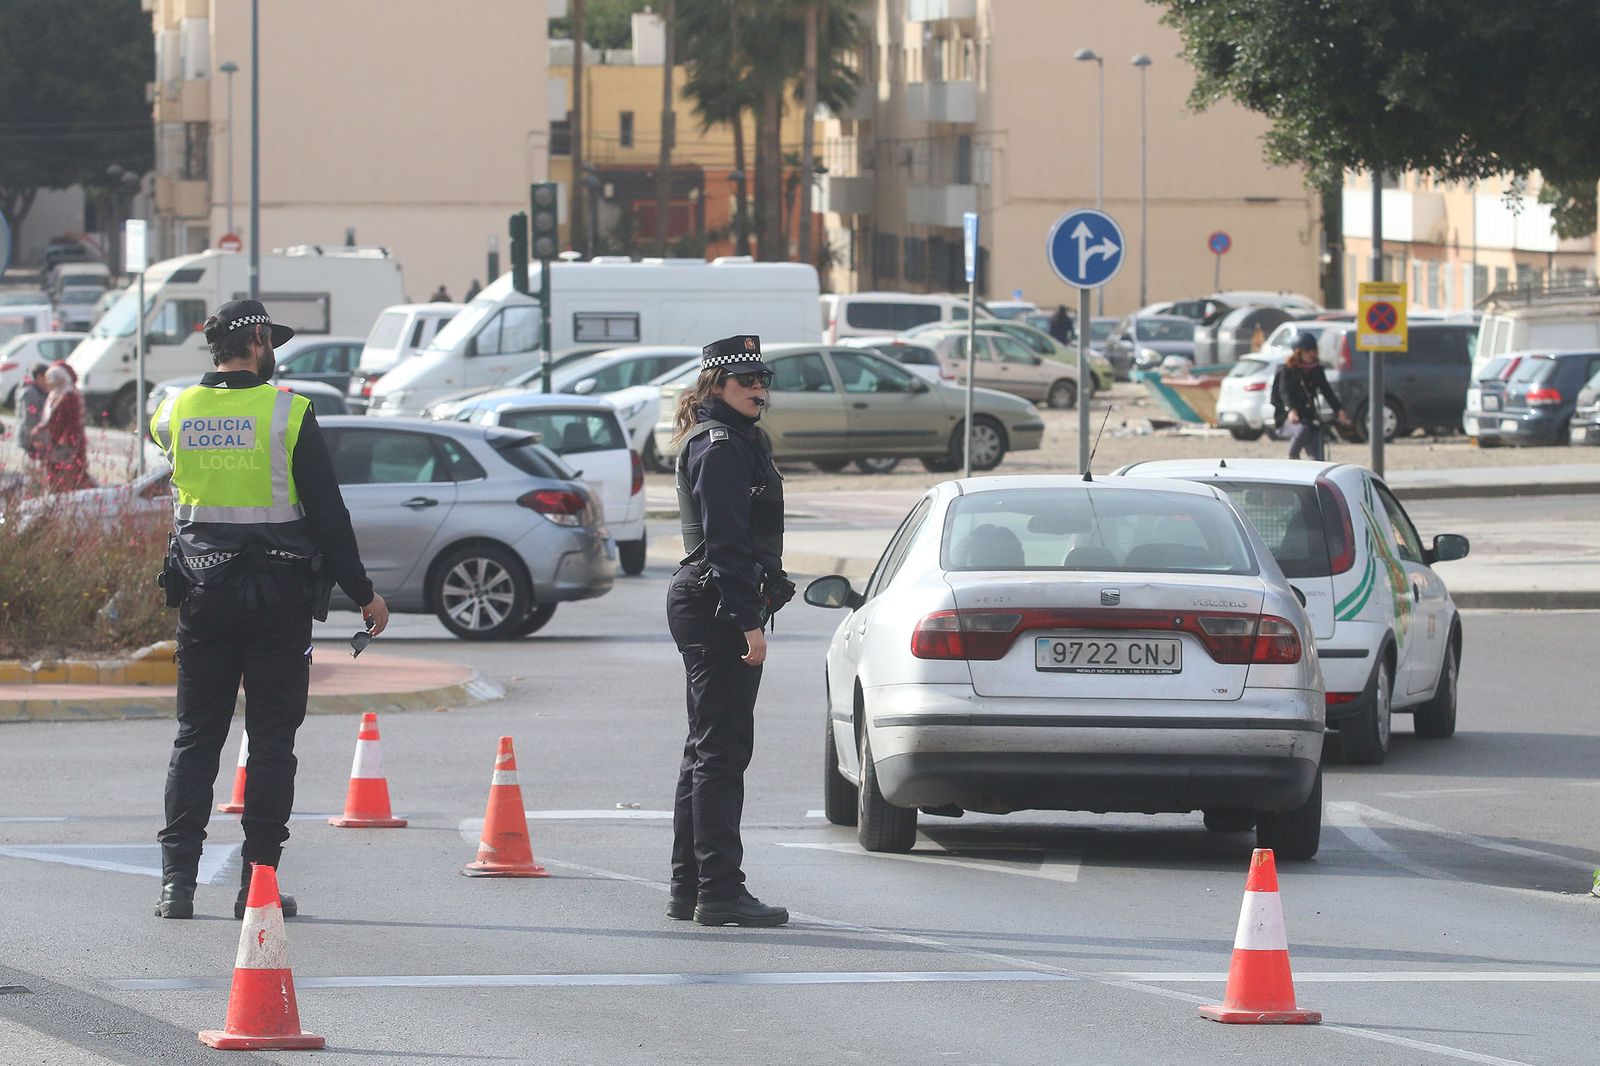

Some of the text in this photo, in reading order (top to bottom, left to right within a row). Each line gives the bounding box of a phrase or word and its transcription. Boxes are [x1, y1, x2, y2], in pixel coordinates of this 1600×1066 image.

[182, 419, 252, 432] POLICIA
[188, 434, 246, 447] LOCAL
[199, 455, 261, 470] LOCAL
[1052, 641, 1176, 666] 9722 CNJ
